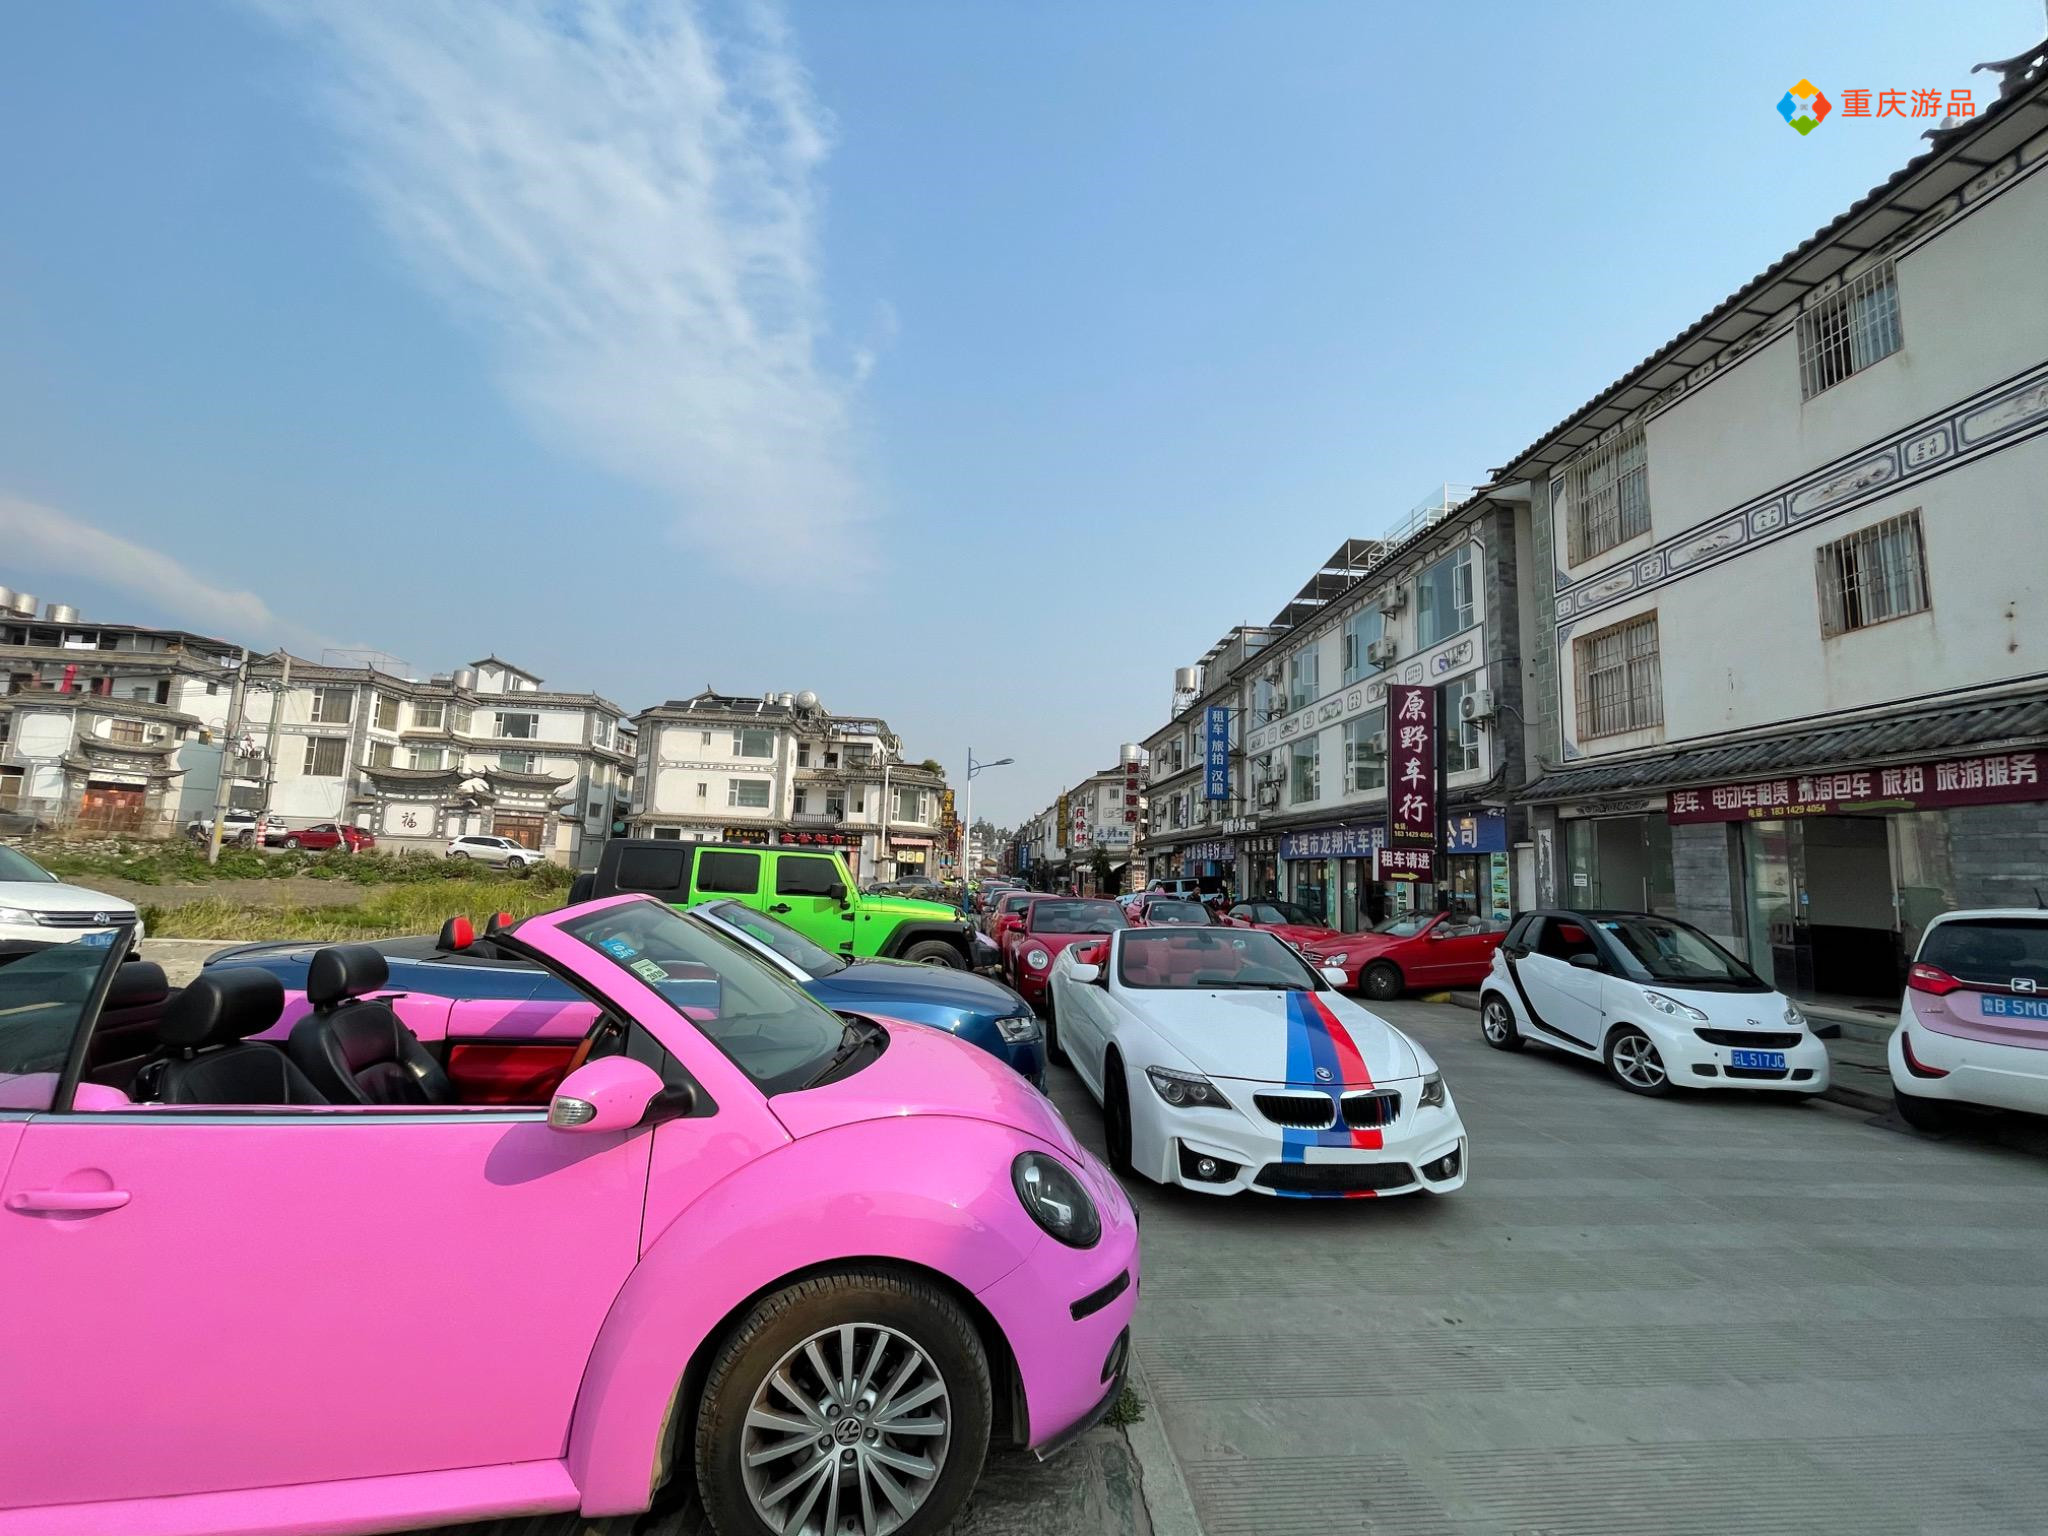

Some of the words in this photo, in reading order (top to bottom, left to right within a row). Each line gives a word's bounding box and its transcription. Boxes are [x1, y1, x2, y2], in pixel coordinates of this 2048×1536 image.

[1211, 710, 1224, 735] 租车
[1211, 740, 1224, 765] 旅拍
[1399, 690, 1429, 823] 原野车行
[1211, 770, 1224, 795] 汉服
[1881, 765, 1924, 796] 旅拍
[1936, 753, 2038, 791] 旅游服务
[402, 812, 417, 828] 福
[1289, 827, 1385, 856] 大理市龙翔汽车租
[1380, 851, 1430, 869] 租车请进
